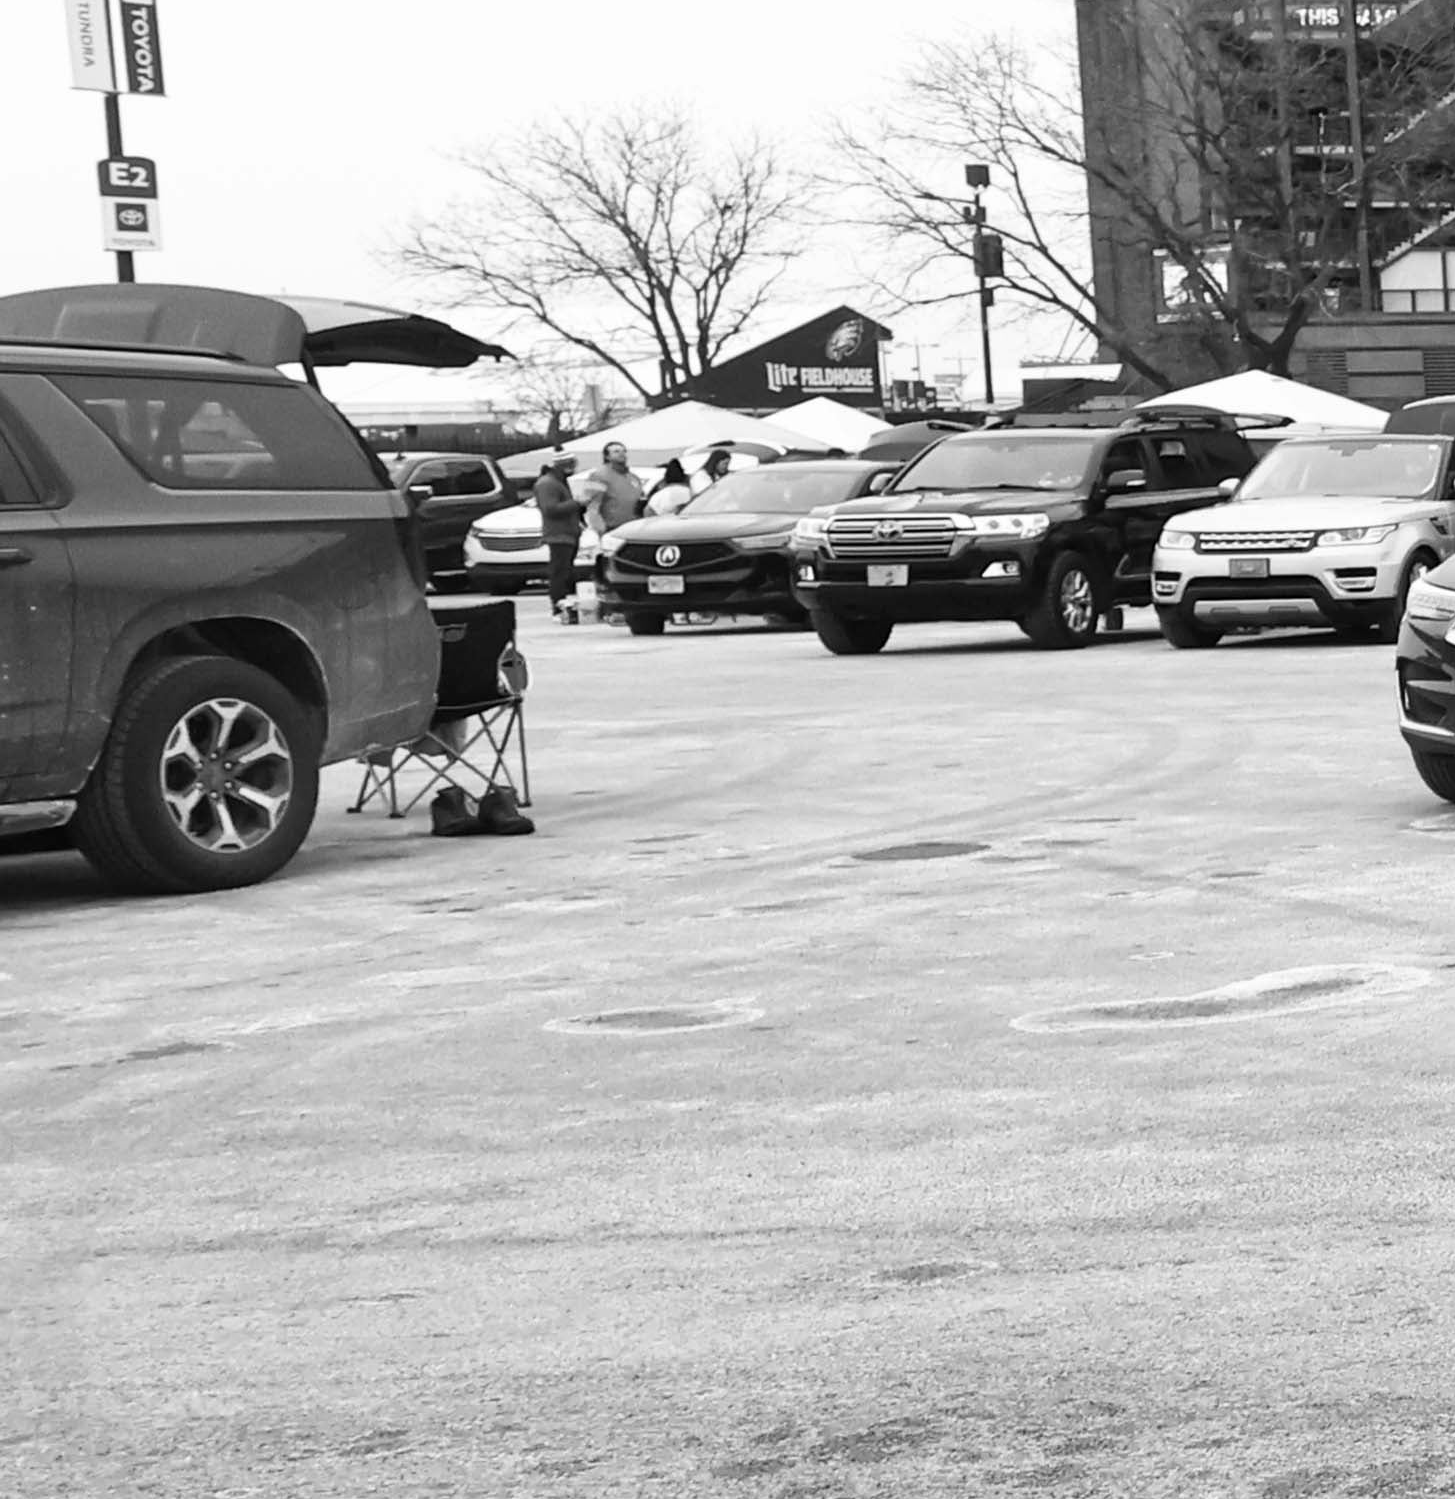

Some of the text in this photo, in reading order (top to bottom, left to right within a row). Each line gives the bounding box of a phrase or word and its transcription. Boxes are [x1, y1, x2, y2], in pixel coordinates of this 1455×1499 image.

[1299, 8, 1339, 26] THIS
[77, 3, 95, 67] TUNDRA
[130, 7, 155, 93] TOYOTA
[108, 161, 150, 187] E2
[765, 362, 874, 392] Lite FIELDHOUSE
